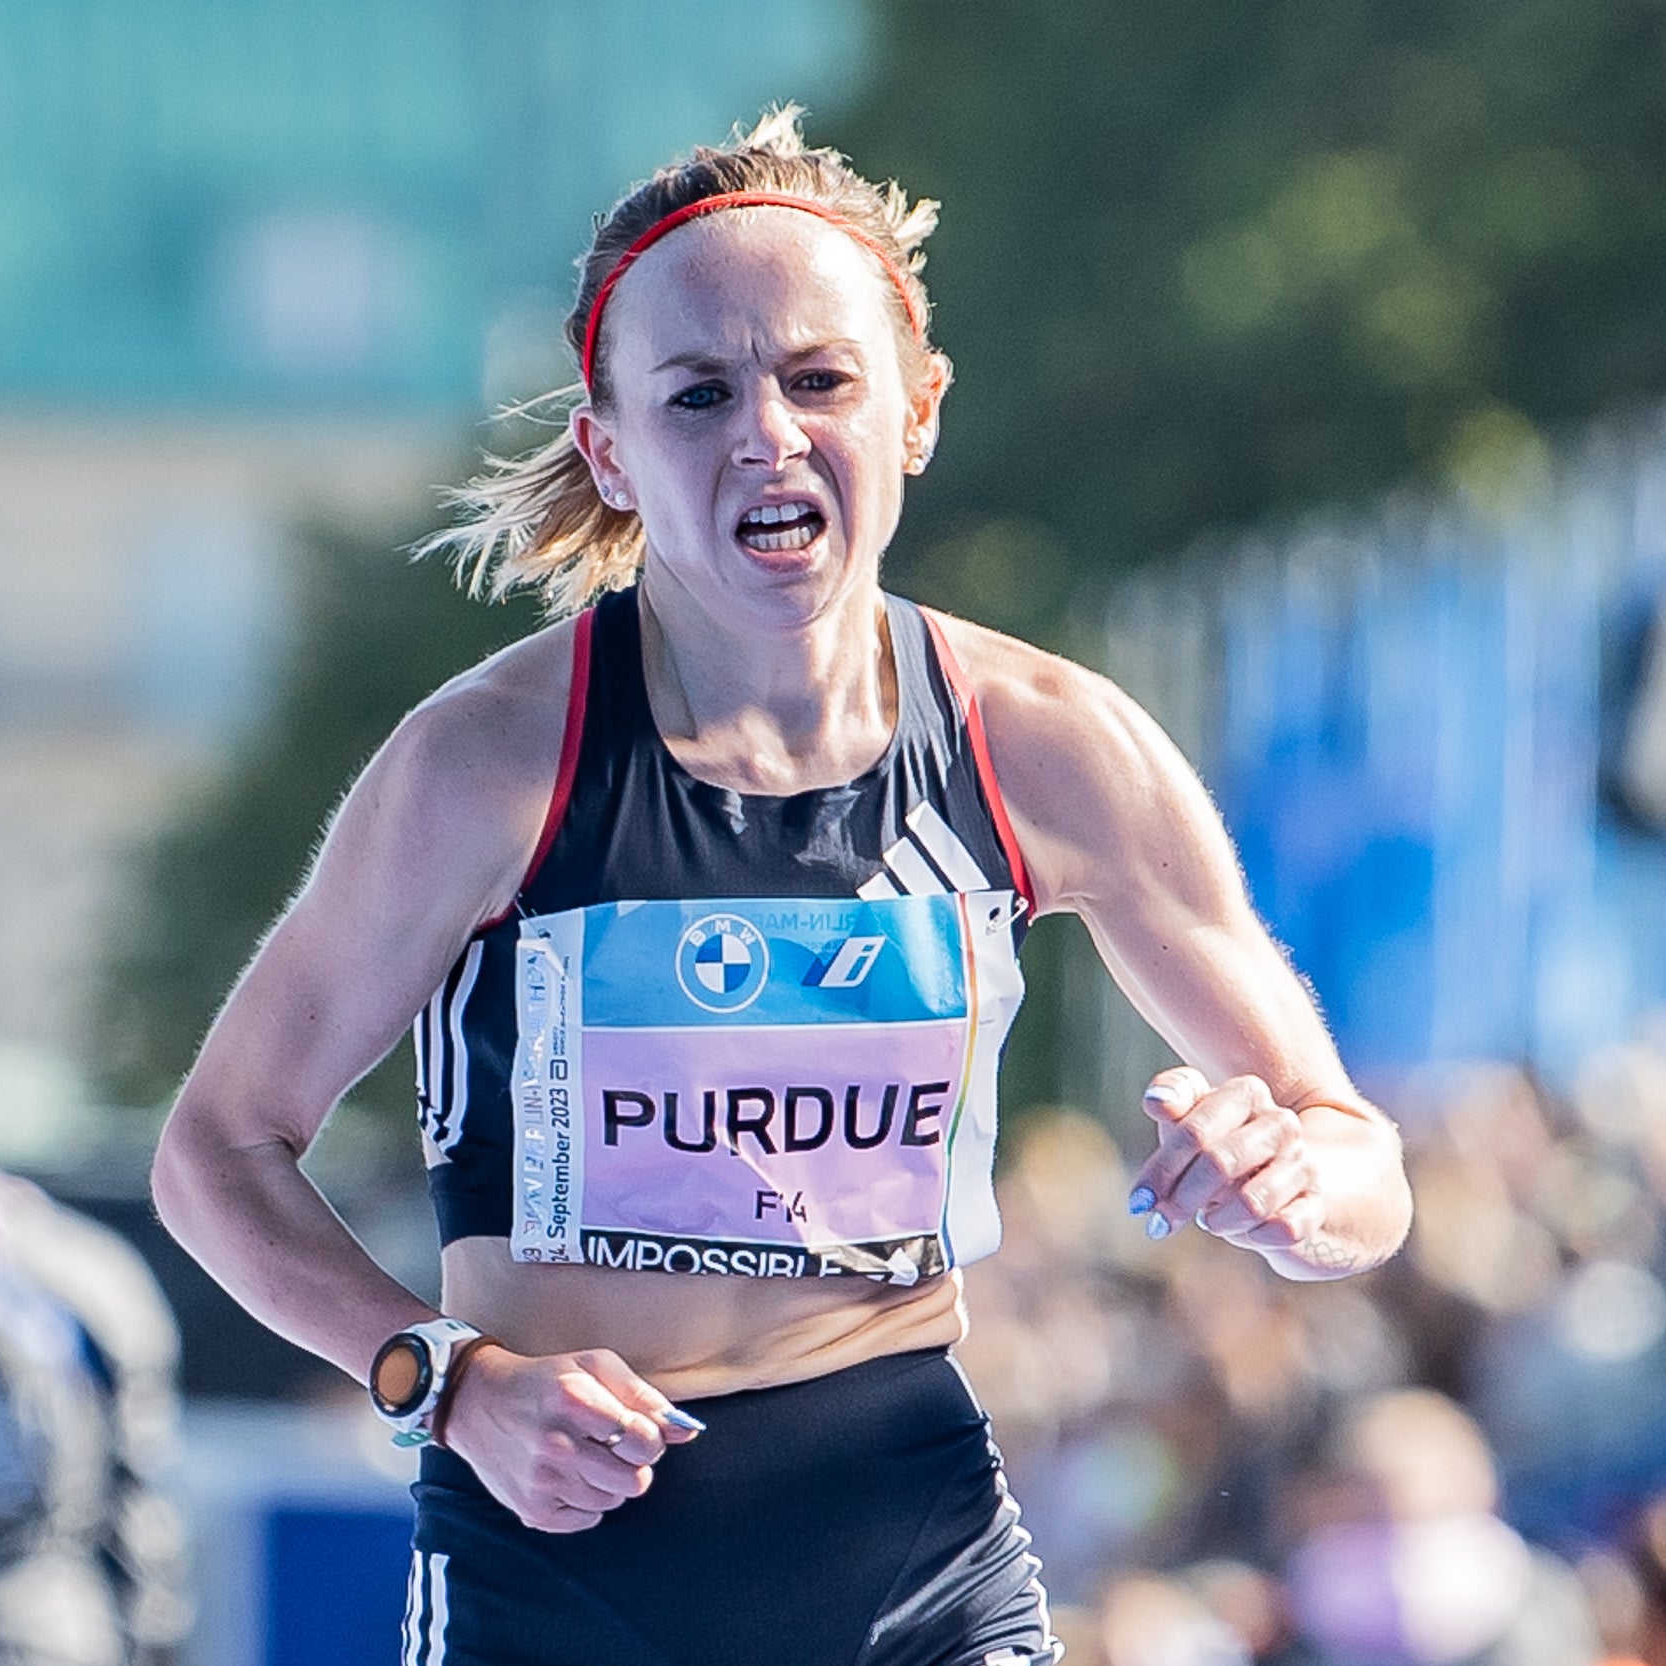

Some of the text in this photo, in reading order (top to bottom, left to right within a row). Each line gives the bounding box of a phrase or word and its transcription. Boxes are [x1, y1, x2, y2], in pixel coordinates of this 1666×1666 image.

[689, 919, 759, 948] BMW
[549, 1087, 570, 1129] 2023
[602, 1081, 950, 1156] PURDUE
[546, 1131, 571, 1239] September
